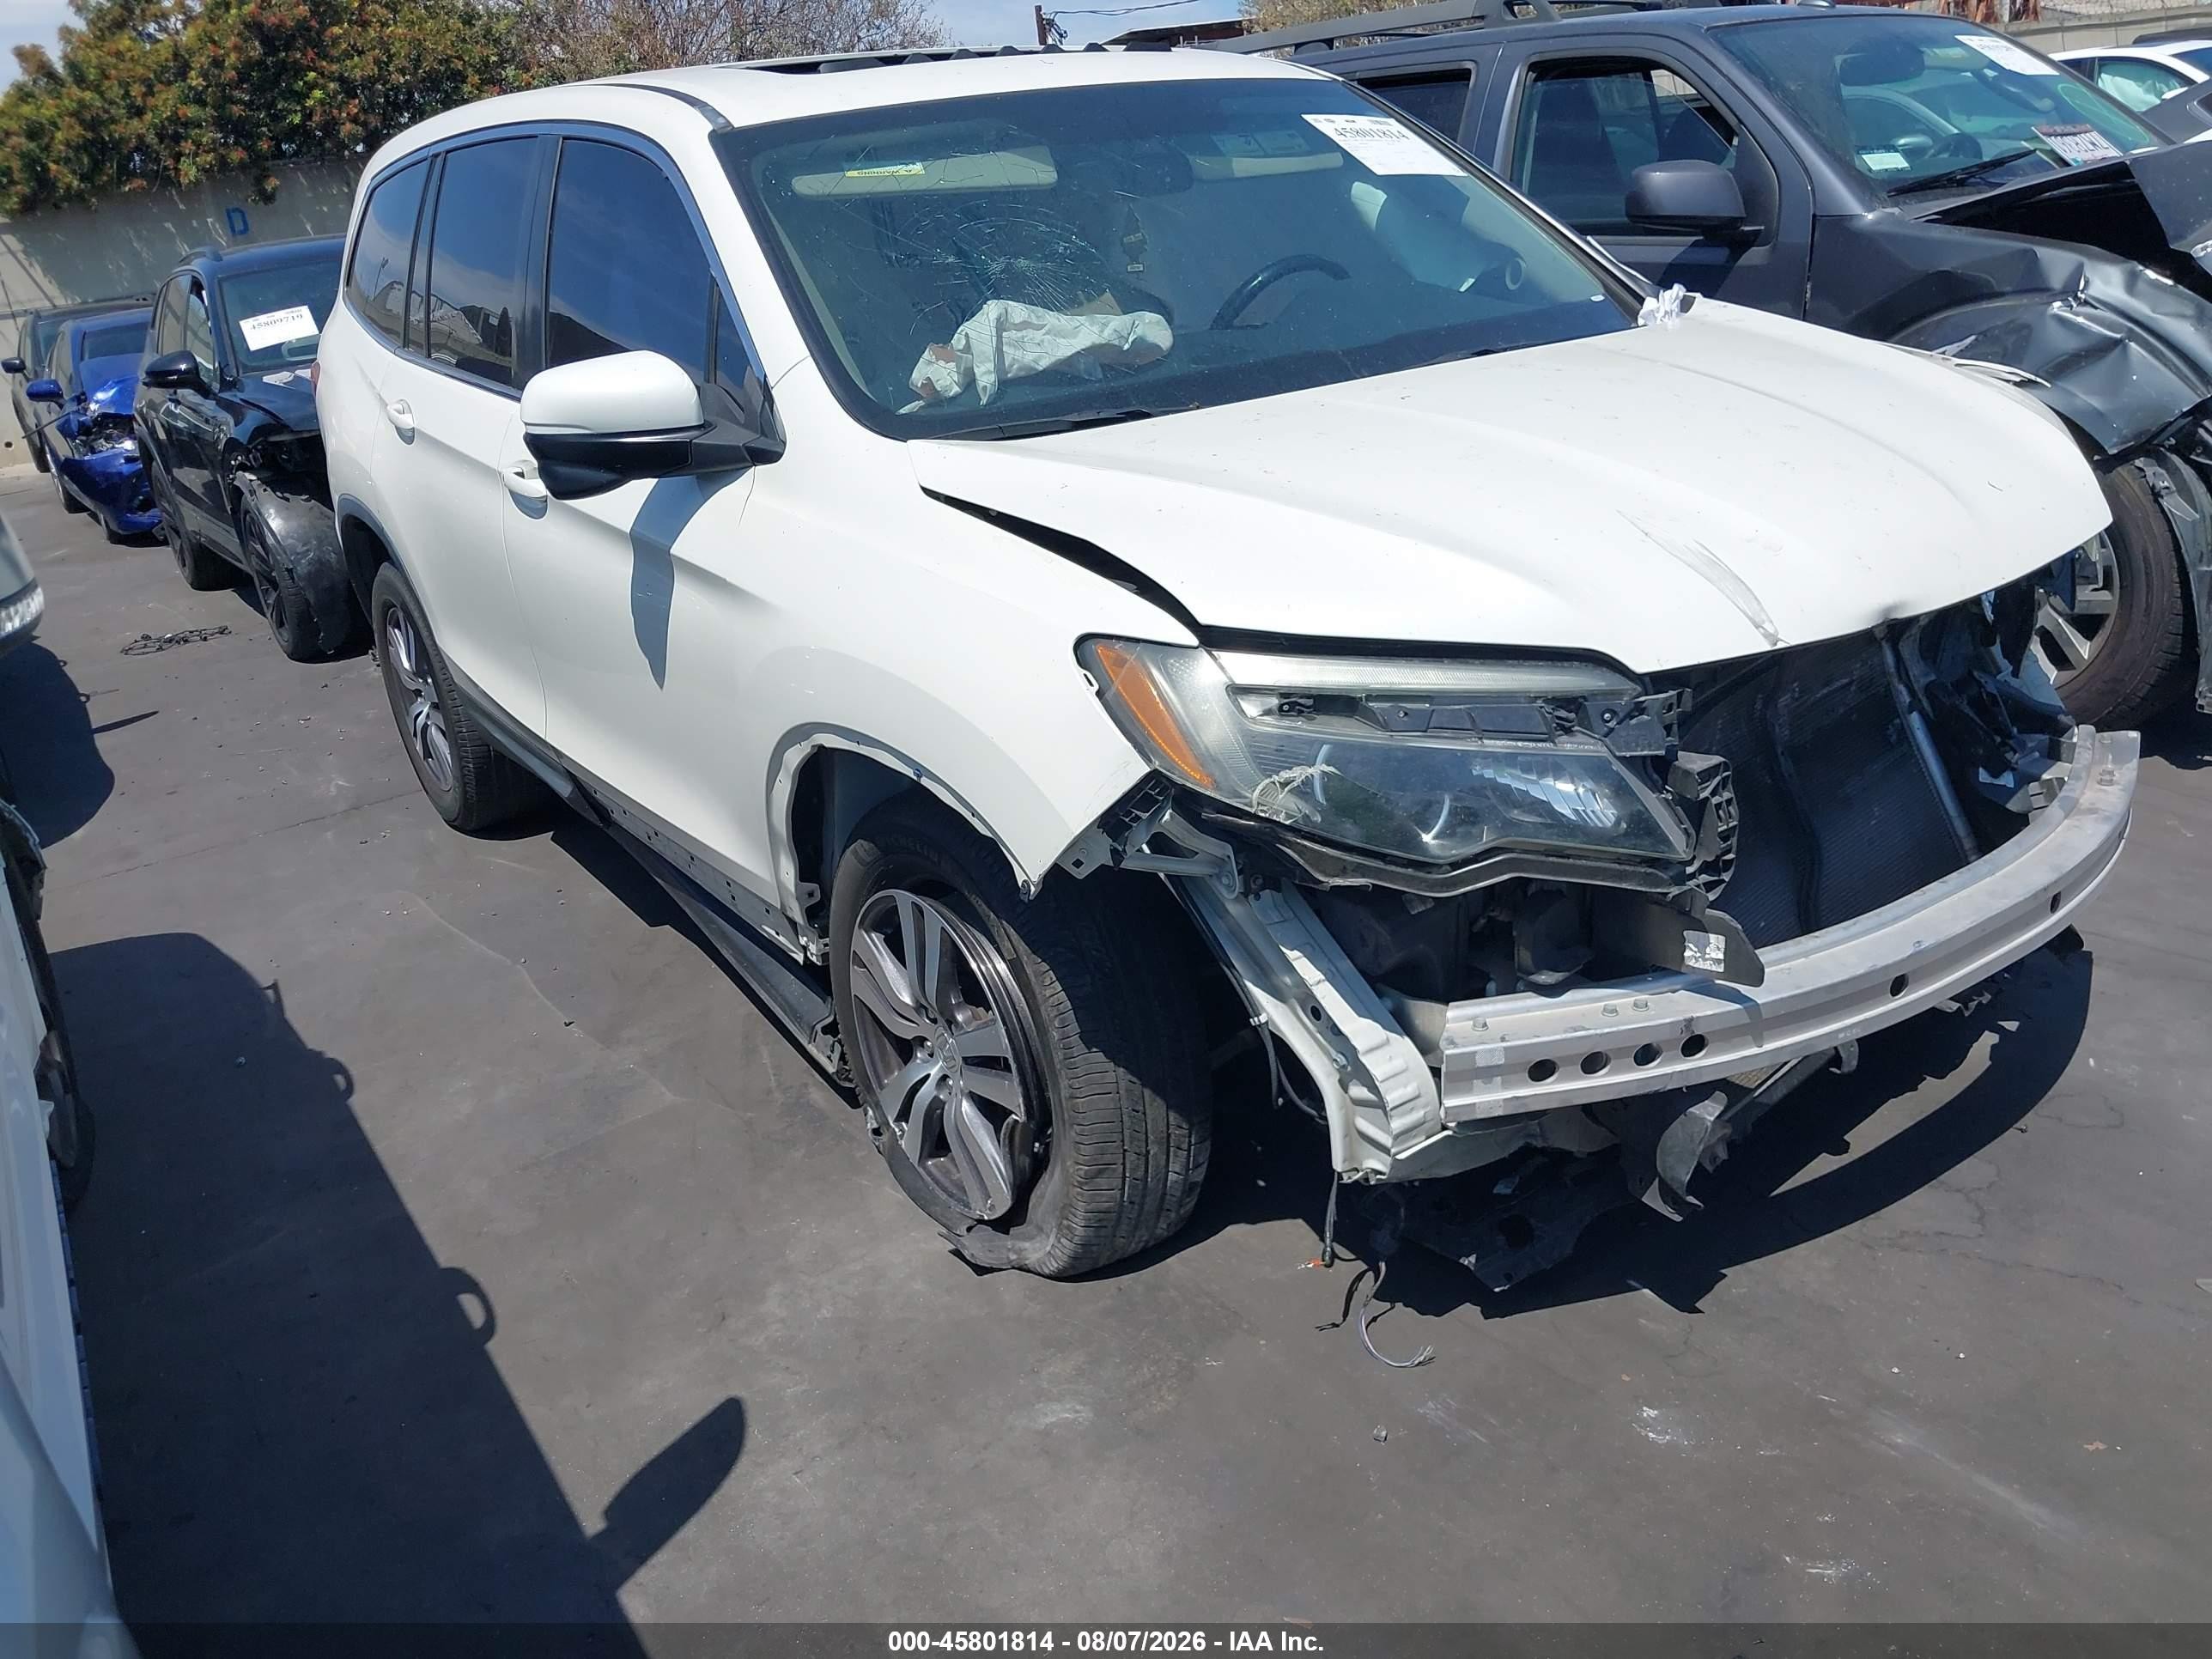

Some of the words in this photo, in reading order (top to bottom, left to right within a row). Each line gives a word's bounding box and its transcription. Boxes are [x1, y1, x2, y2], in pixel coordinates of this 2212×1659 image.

[1334, 127, 1409, 140] 45801814
[226, 208, 249, 234] D
[251, 314, 303, 329] 45809719
